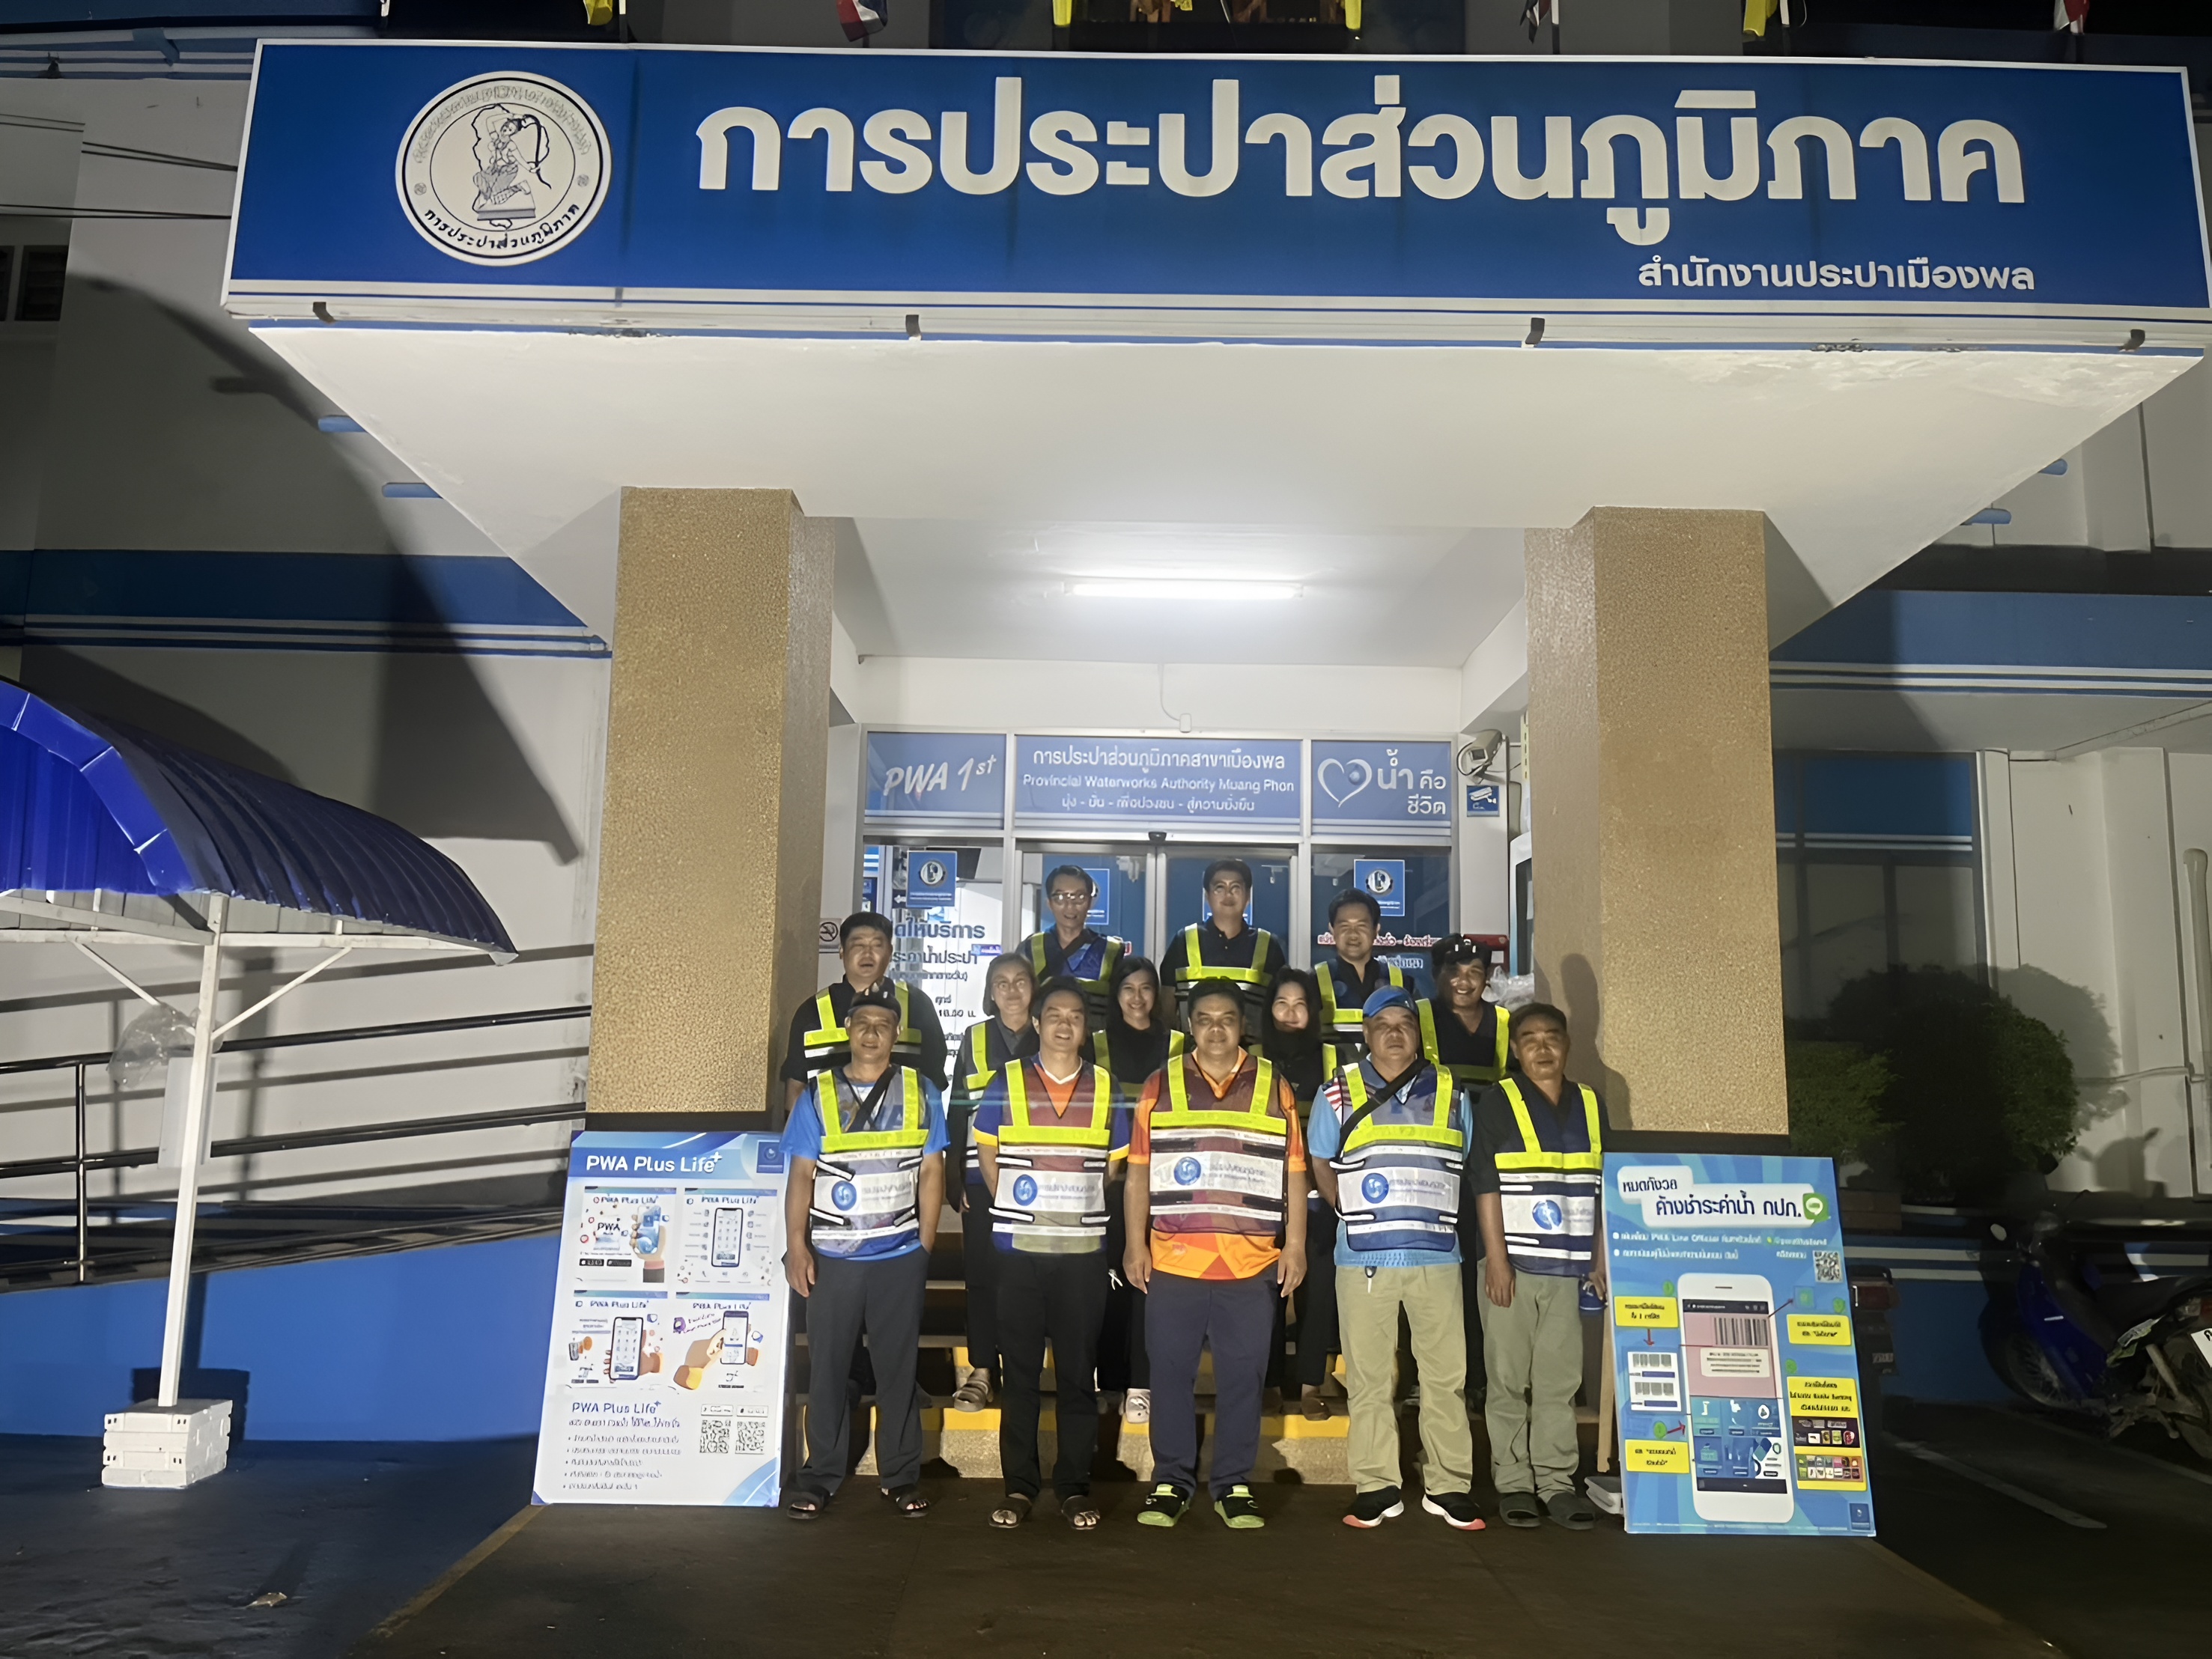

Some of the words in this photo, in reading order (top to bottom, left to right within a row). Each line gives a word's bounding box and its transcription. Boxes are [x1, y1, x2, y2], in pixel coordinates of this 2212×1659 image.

[696, 75, 2025, 246] การประปาส่วนภูมิภาค
[424, 203, 581, 249] การประปาส่วนภูมิภาค
[1638, 255, 2035, 290] สำนักงานประปาเมืองพล
[1033, 745, 1285, 773] การประปาส่วนภูมิภาคสาขาเมืองพล
[1377, 749, 1414, 790] น้ำ
[1419, 769, 1447, 790] คือ
[883, 761, 949, 796] PWA
[957, 754, 997, 791] 1st
[1023, 773, 1082, 787] Provincial
[1084, 776, 1158, 789] Waterworks
[1161, 777, 1215, 793] Authority
[1407, 793, 1446, 815] ชีวิต
[586, 1154, 628, 1172] PWA
[634, 1155, 675, 1172] Plus
[1656, 1190, 1755, 1216] ค้างชำระค่าน้ำ
